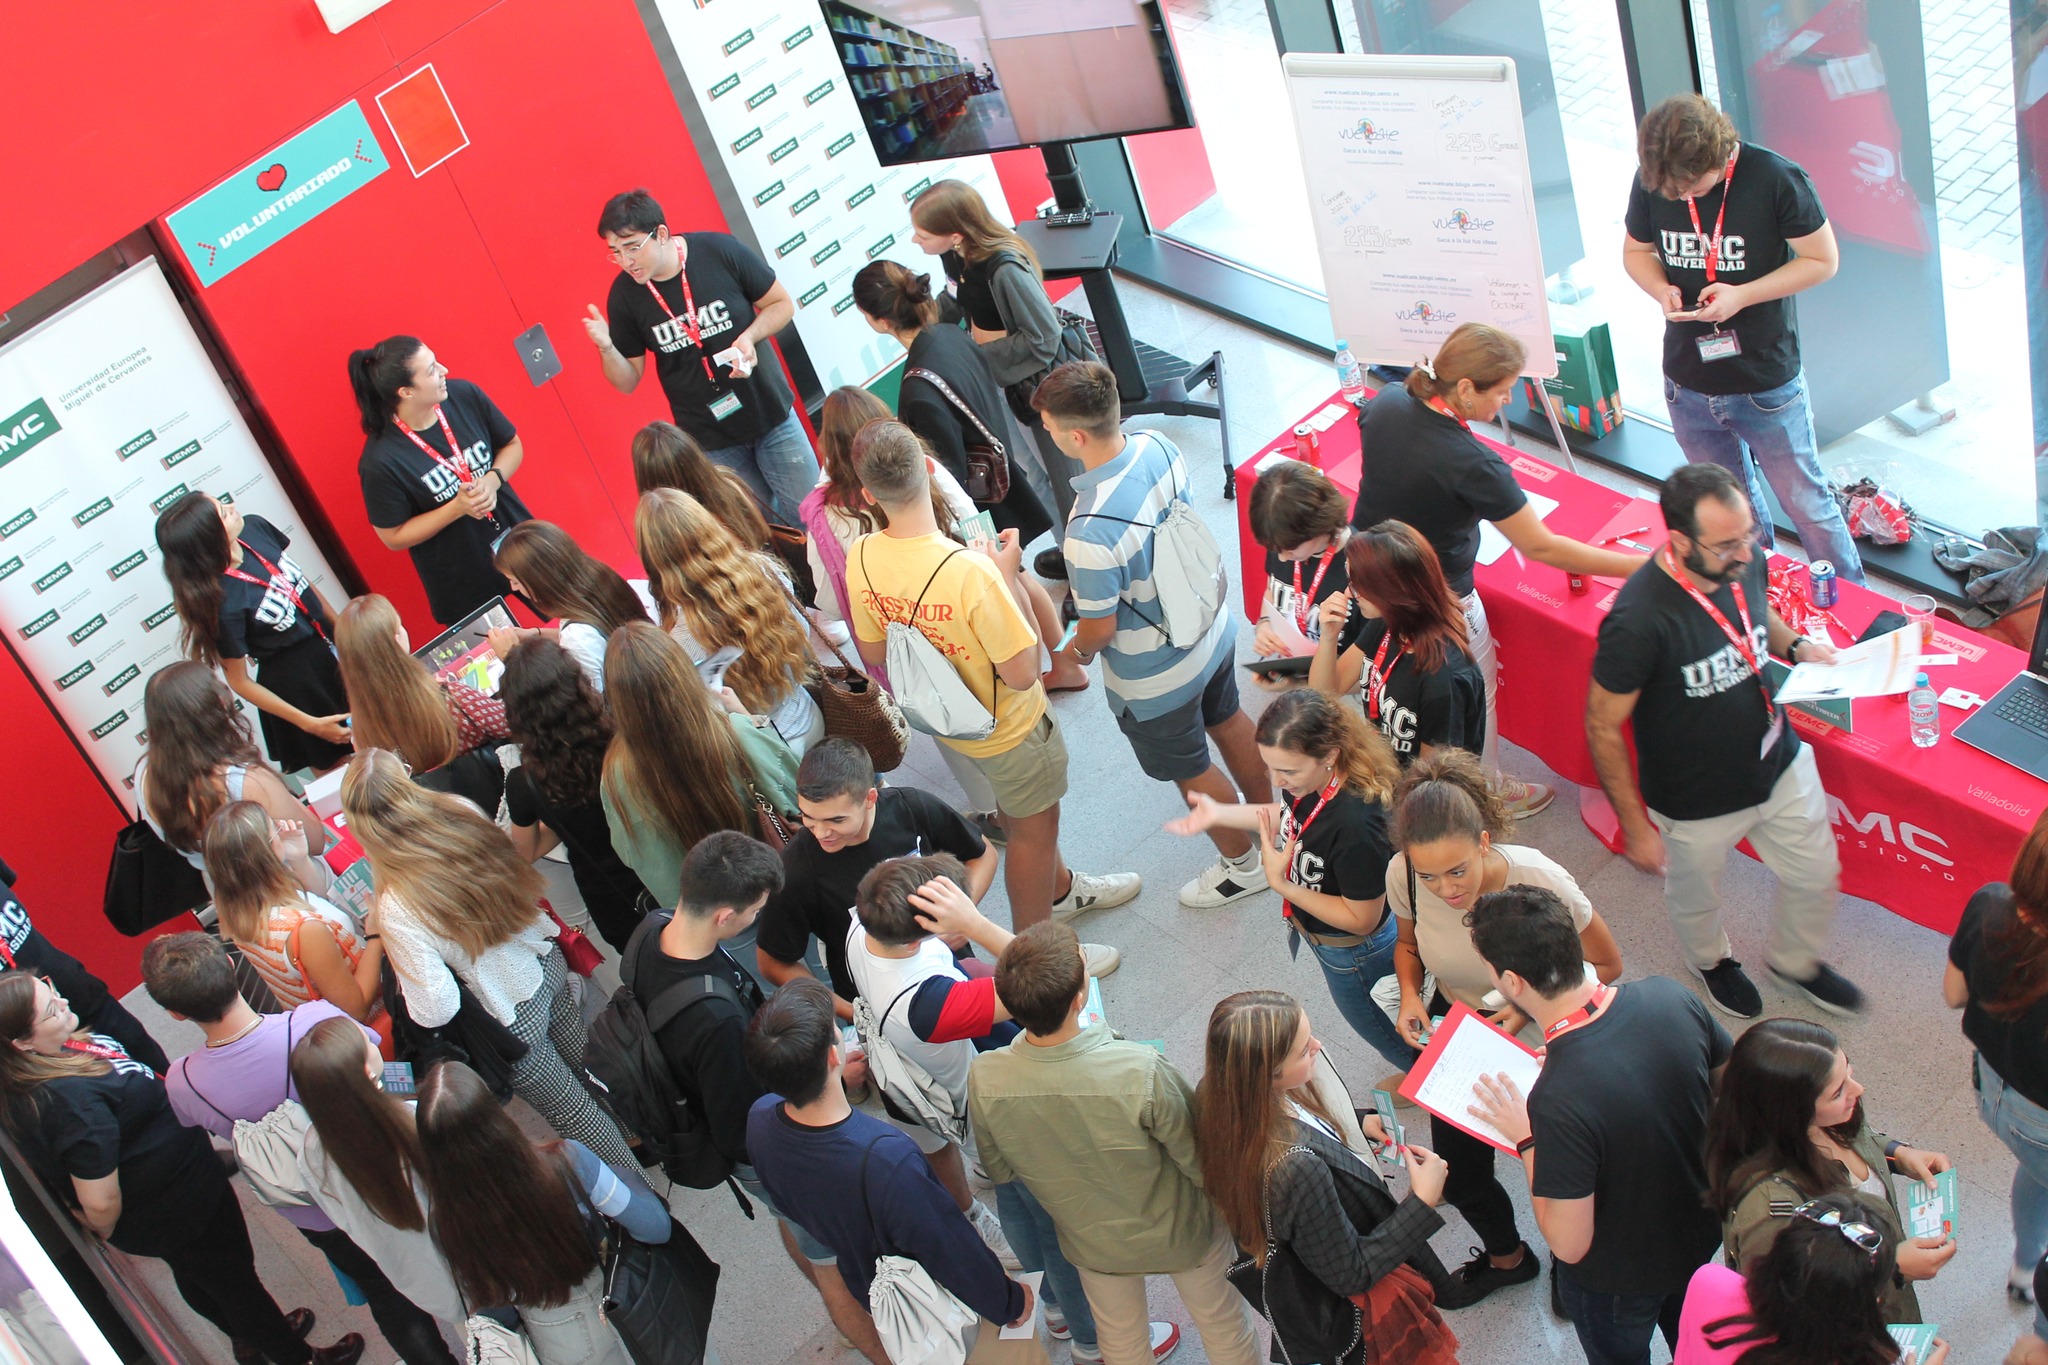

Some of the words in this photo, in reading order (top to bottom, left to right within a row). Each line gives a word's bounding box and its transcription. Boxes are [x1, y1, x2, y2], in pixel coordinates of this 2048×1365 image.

[218, 156, 353, 250] VOLUNTARIADO
[59, 367, 110, 403] Universidad
[110, 346, 148, 371] Europea
[64, 389, 94, 412] Miguel
[95, 382, 107, 392] de
[107, 355, 153, 384] Cervantes
[122, 433, 152, 456] UEMC
[167, 443, 198, 465] UEMC
[156, 487, 186, 509] UEMC
[78, 501, 109, 523] UEMC
[1, 513, 33, 535] UEMC
[113, 553, 144, 576] UEMC
[1312, 563, 1327, 587] UEMC
[38, 566, 69, 589] UEMC
[861, 589, 905, 614] KISS
[902, 597, 953, 622] YOUR
[1514, 581, 1564, 609] Valladolid
[25, 612, 56, 634] UEMC
[74, 618, 103, 641] UEMC
[1933, 635, 1975, 656] UEMC
[62, 664, 91, 686] UEMC
[109, 668, 137, 690] UEMC
[96, 713, 125, 735] UEMC
[1787, 708, 1827, 731] UEMC
[1966, 783, 2031, 818] Valladolid
